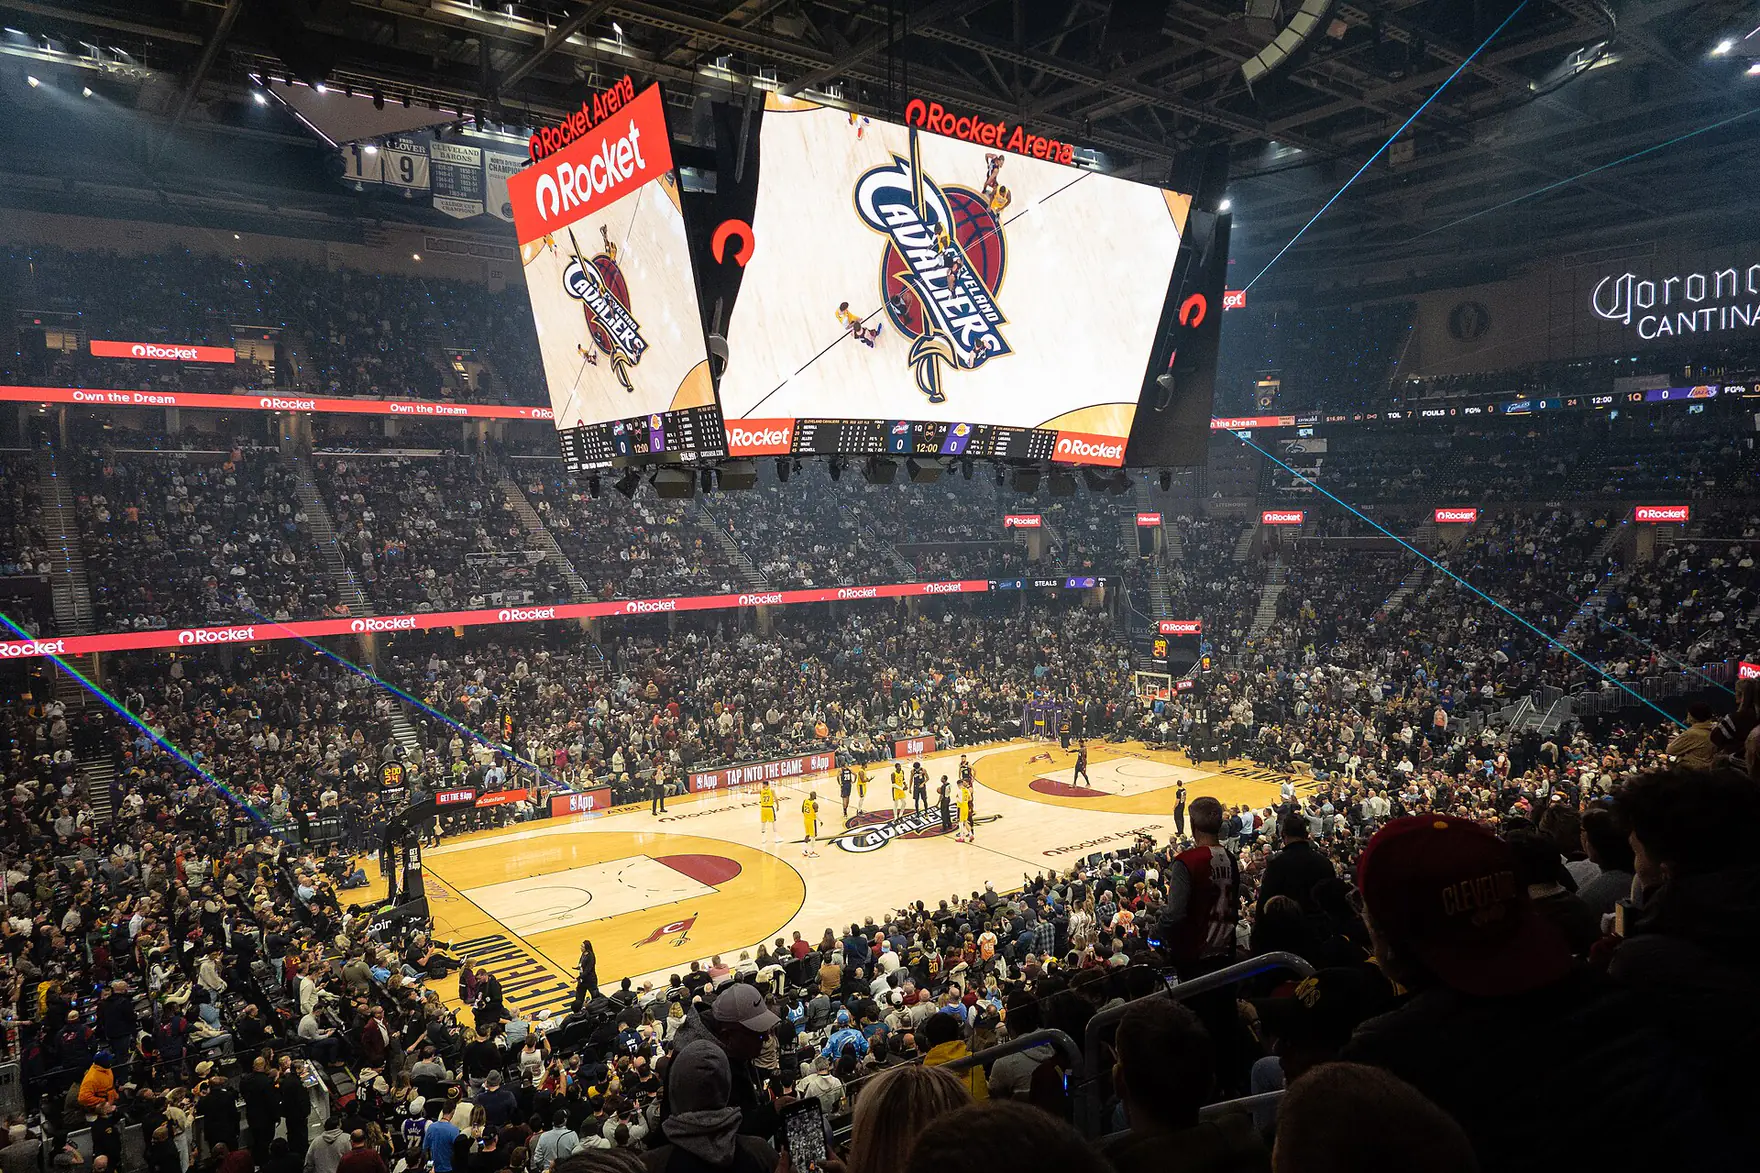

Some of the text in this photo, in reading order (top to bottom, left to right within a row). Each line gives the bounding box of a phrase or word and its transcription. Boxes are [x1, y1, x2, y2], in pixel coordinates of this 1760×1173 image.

[541, 75, 634, 152] Rocket Arena
[927, 102, 1075, 165] Rocket Arena
[432, 143, 479, 156] CLEVELAND
[440, 152, 472, 162] BARONS
[401, 156, 414, 183] 9
[556, 118, 646, 211] Rocket
[147, 347, 197, 359] Rocket
[1662, 391, 1668, 399] 0
[1725, 385, 1745, 394] FG%
[73, 391, 175, 404] Own the Dream
[1592, 396, 1612, 404] 12:00
[1627, 392, 1642, 402] 1Q
[273, 399, 315, 410] Rocket
[390, 403, 467, 415] Own the Dream
[1488, 405, 1493, 413] 0
[1540, 401, 1546, 409] 0
[1232, 419, 1257, 427] Dream
[938, 425, 946, 433] 24
[654, 437, 660, 449] 0
[731, 428, 789, 447] Rocket
[620, 441, 626, 453] 0
[633, 443, 648, 454] 12:00
[896, 439, 903, 450] 0
[916, 443, 938, 453] 12:00
[950, 441, 957, 452] 0
[1072, 442, 1122, 459] Rocket
[1272, 512, 1300, 521] Rocket
[1445, 511, 1474, 520] Rocket
[1648, 509, 1685, 519] Rocket
[1013, 517, 1039, 526] Rocket
[934, 583, 962, 592] Rocket
[1016, 580, 1021, 588] 0
[1070, 579, 1075, 587] 0
[846, 588, 877, 598] Rocket
[749, 593, 782, 605] Rocket
[638, 600, 676, 612] Rocket
[512, 608, 555, 621] Rocket
[365, 616, 416, 631] Rocket
[195, 626, 254, 642] Rocket
[1153, 647, 1166, 657] 24
[913, 741, 924, 753] App
[817, 757, 829, 770] App
[384, 768, 402, 776] 12:00
[727, 759, 803, 785] TAP INTO THE GAME
[385, 776, 399, 785] 24
[704, 774, 718, 788] App
[578, 794, 594, 811] App
[608, 805, 641, 814] AT&T
[673, 805, 739, 820] Rocket
[1056, 835, 1119, 854] Rocket
[929, 962, 938, 973] 20
[357, 1086, 367, 1101] 45
[407, 1135, 421, 1149] 77
